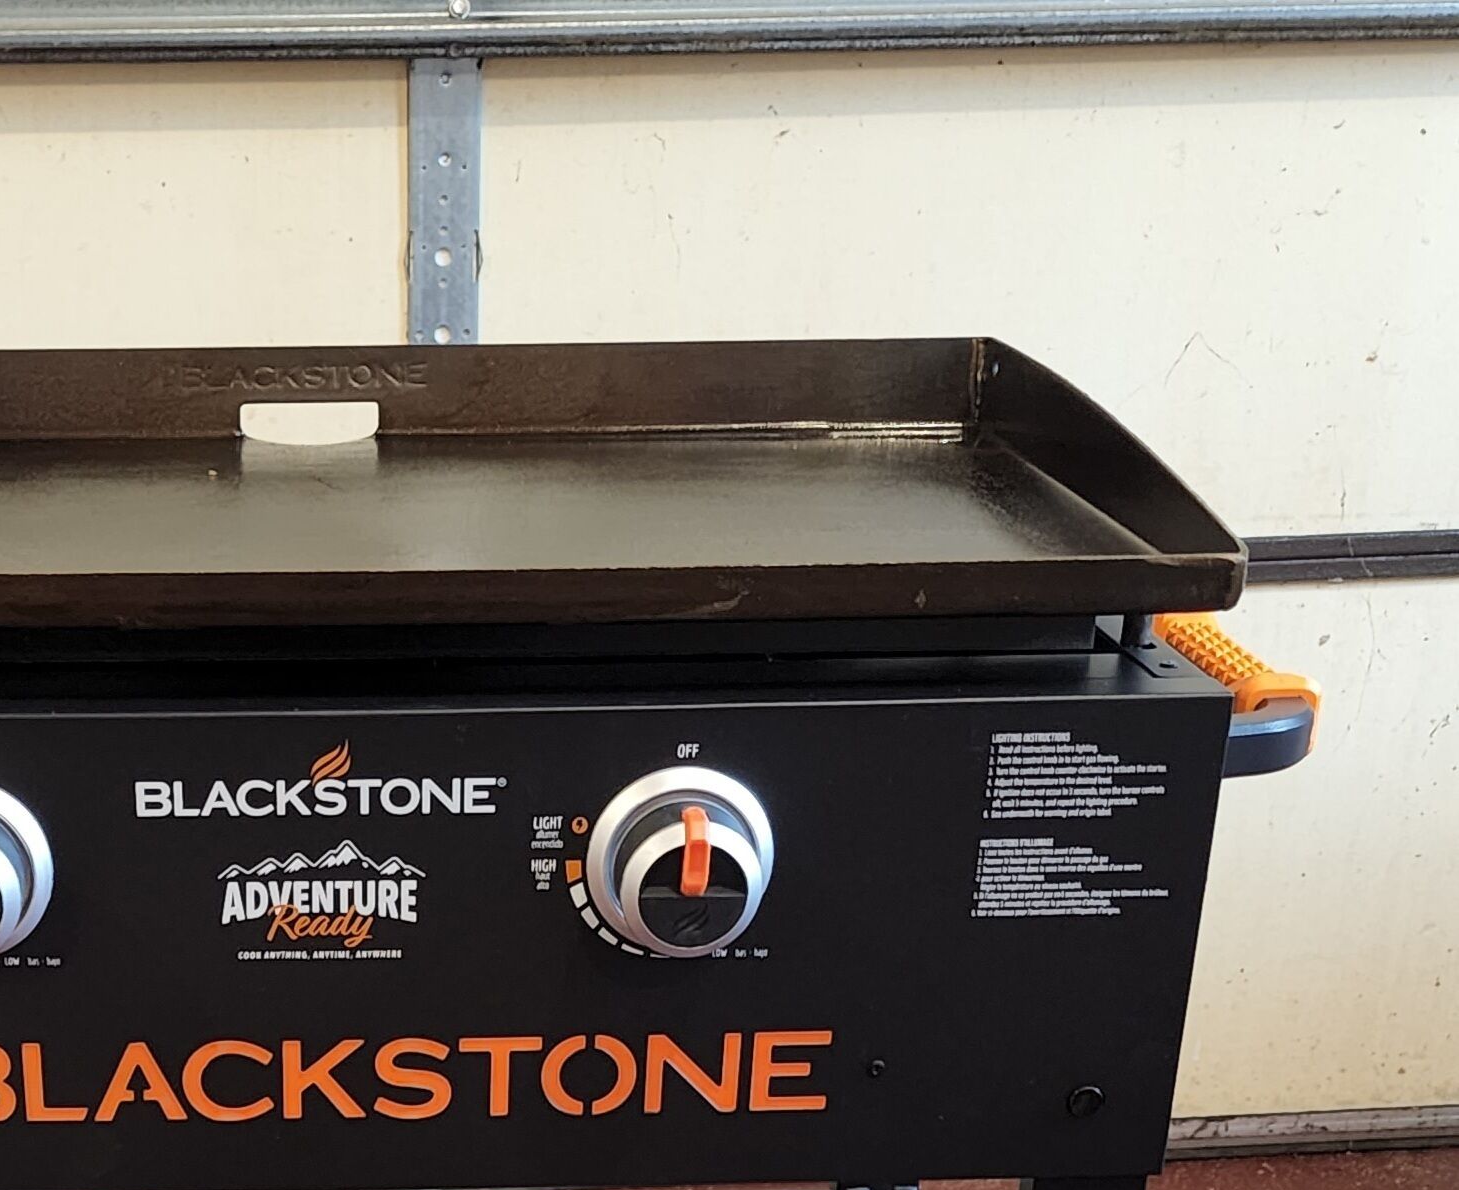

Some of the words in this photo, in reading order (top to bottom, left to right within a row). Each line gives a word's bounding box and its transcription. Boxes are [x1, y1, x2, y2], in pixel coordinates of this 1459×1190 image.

[181, 363, 428, 391] BLACKSTONE
[677, 744, 699, 758] OFF
[135, 776, 497, 818] BLACKSTONE
[533, 816, 563, 830] LIGHT
[531, 859, 557, 872] HIGH
[221, 879, 417, 925] ADVENTURE
[267, 904, 373, 947] Ready
[237, 950, 261, 960] COOK
[711, 948, 727, 958] LOW
[4, 956, 19, 966] LOW
